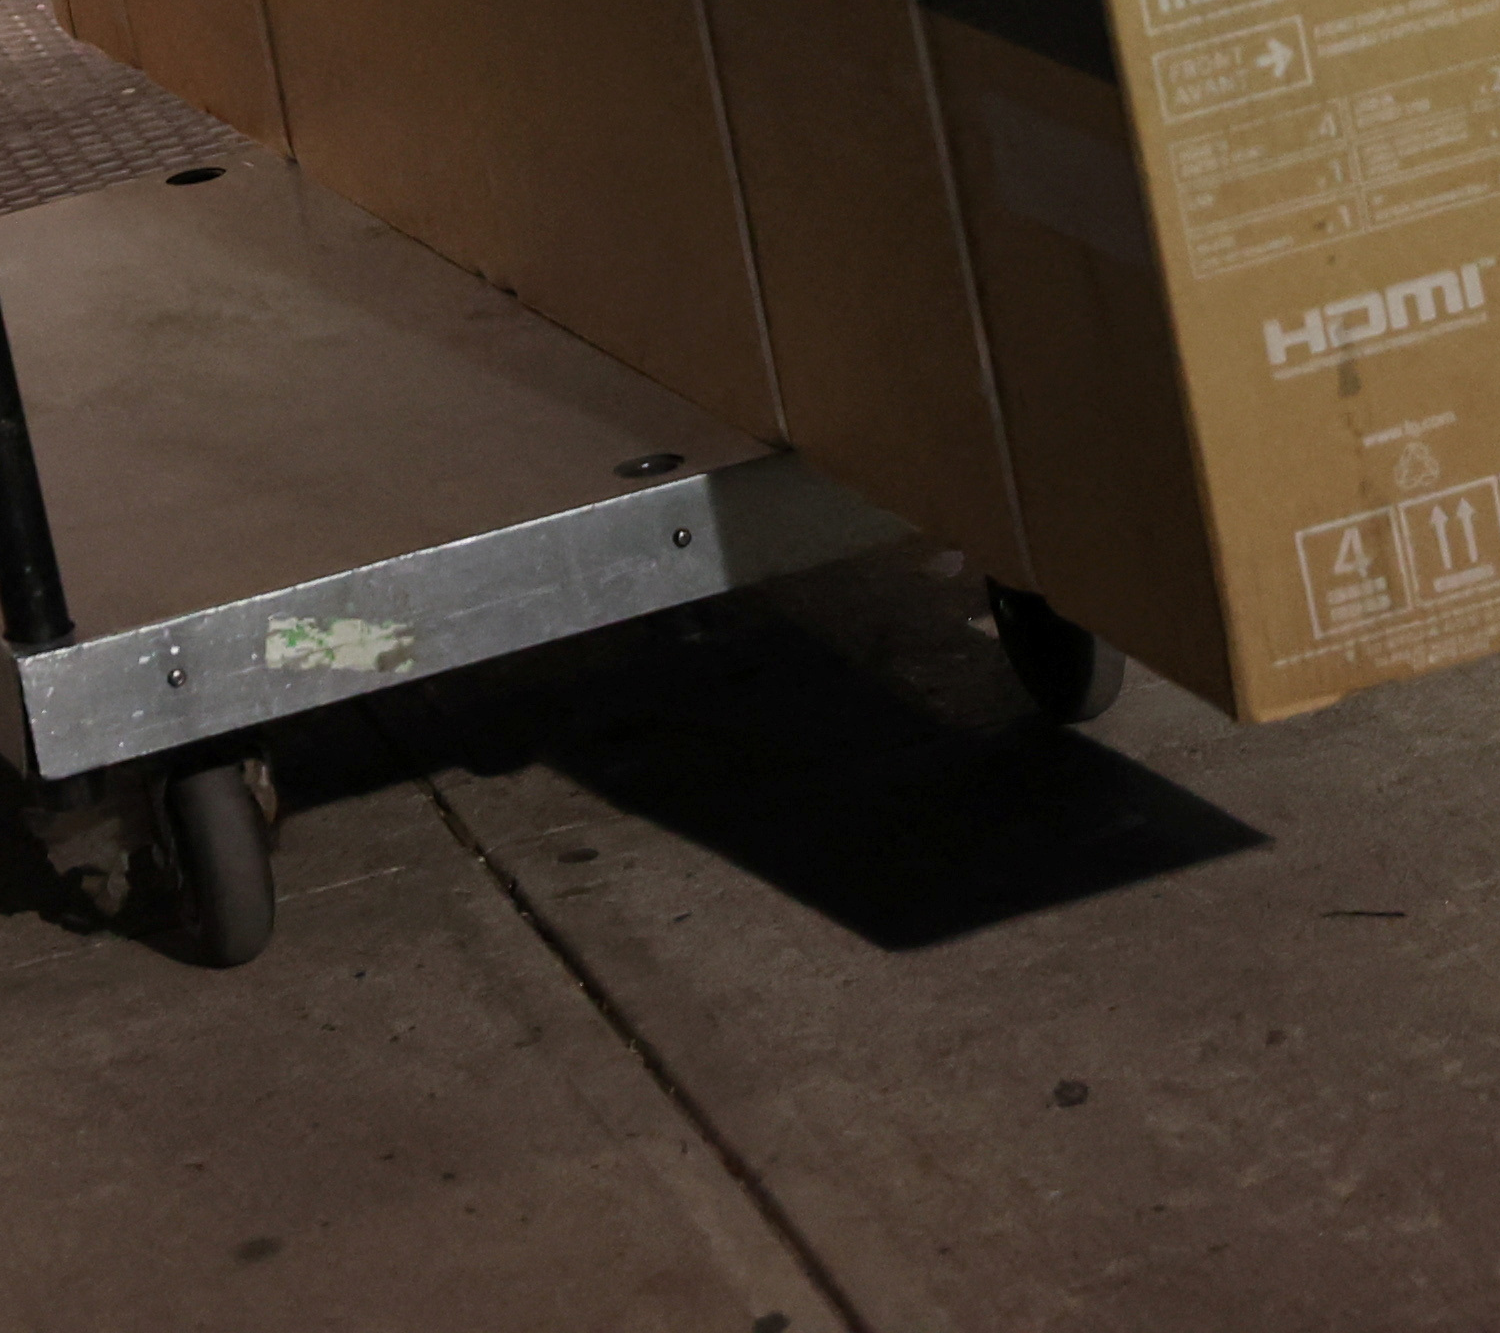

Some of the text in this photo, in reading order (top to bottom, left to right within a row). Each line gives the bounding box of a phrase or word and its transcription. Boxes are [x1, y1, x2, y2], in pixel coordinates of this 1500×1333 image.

[1166, 45, 1248, 88] FRONT
[1174, 71, 1250, 110] AVANT
[1261, 257, 1488, 366] HDMI
[1332, 527, 1374, 581] 4
